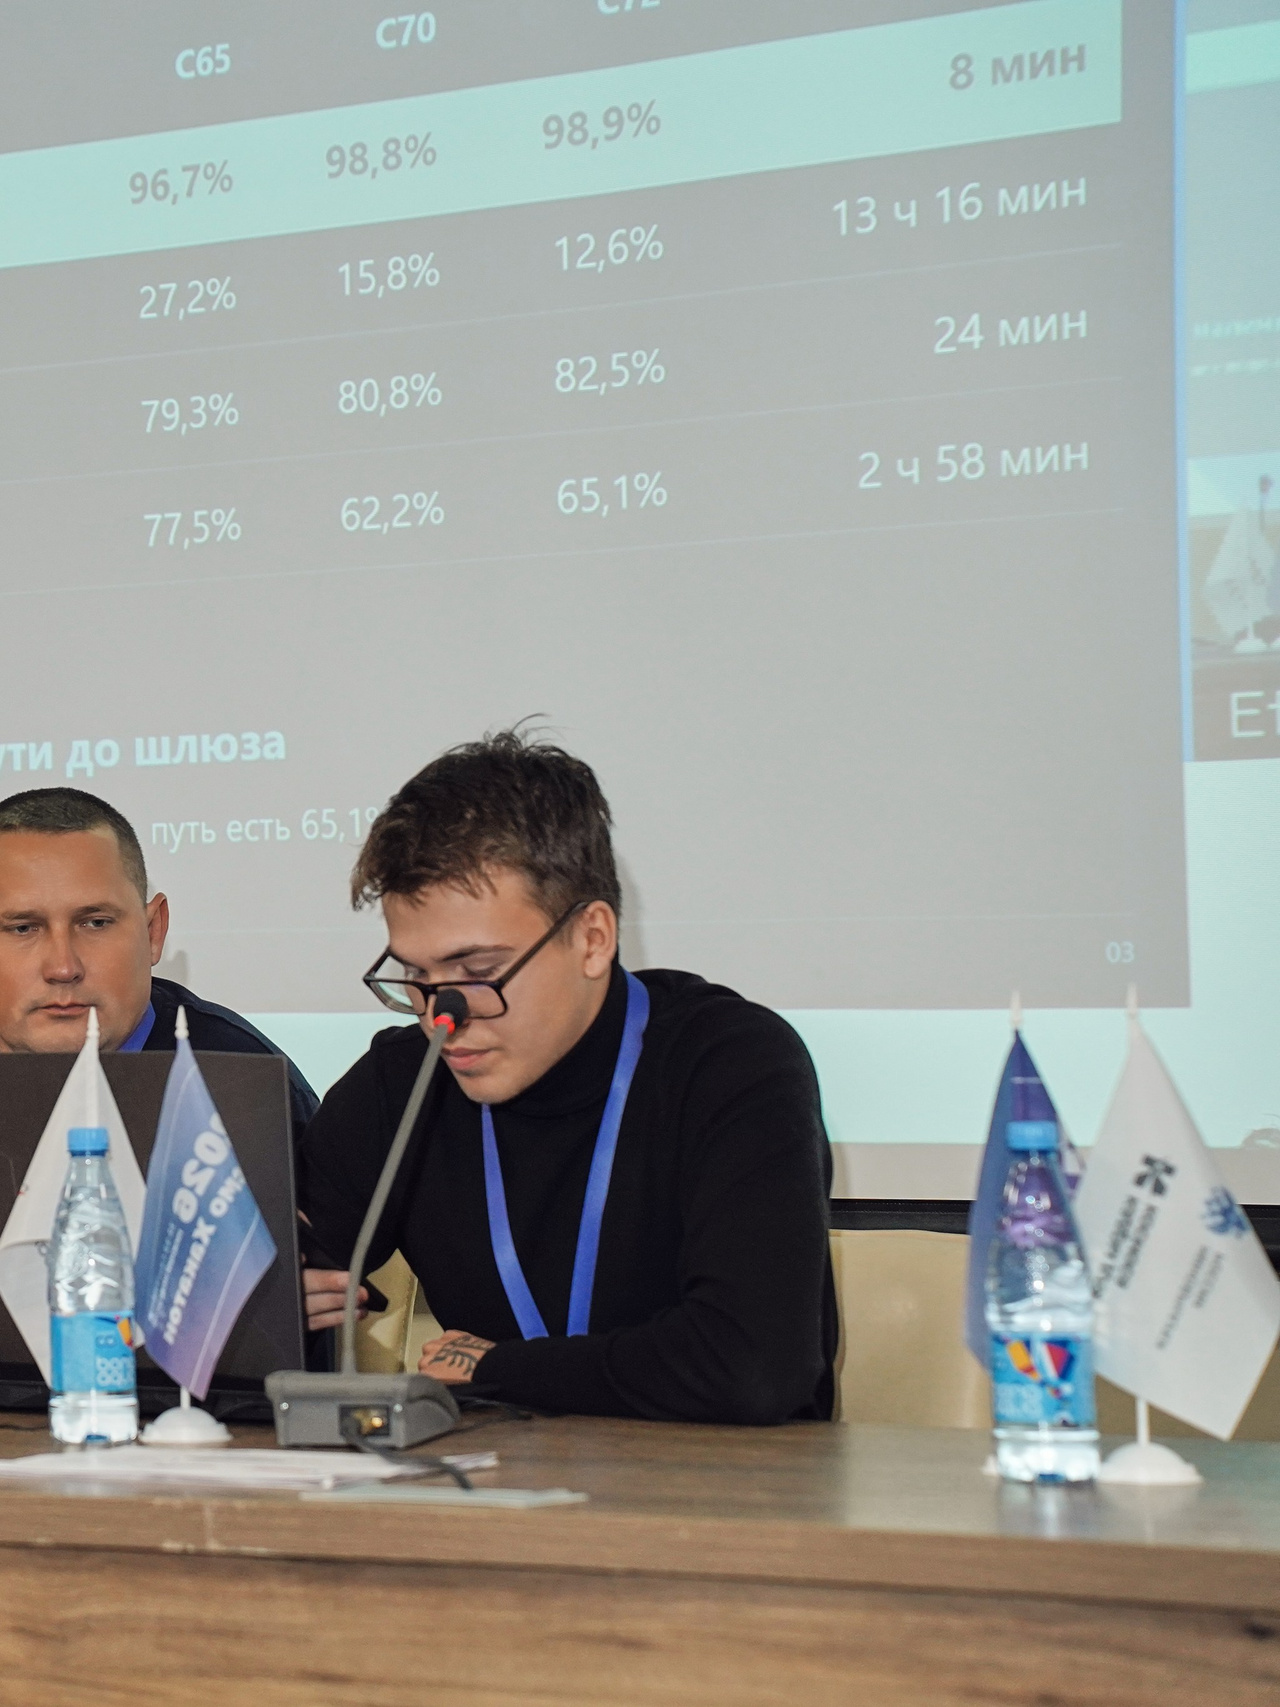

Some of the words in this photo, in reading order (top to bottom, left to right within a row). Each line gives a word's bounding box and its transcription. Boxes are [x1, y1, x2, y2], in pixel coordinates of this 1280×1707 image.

[949, 52, 975, 91] 8
[990, 43, 1087, 86] мин
[542, 99, 662, 150] 98,9%
[325, 131, 438, 180] 98,8%
[128, 159, 234, 206] 96,7%
[832, 196, 877, 236] 13
[894, 199, 918, 228] ч
[935, 181, 984, 224] 16
[996, 177, 1088, 217] мин
[554, 223, 665, 273] 12,6%
[337, 251, 441, 298] 15,8%
[138, 276, 237, 321] 27,2%
[933, 313, 985, 355] 24
[999, 310, 1088, 347] мин
[337, 371, 443, 417] 80,8%
[553, 347, 667, 396] 82,5%
[140, 392, 240, 436] 79,3%
[858, 451, 882, 490] 2
[897, 456, 920, 484] ч
[936, 442, 986, 483] 58
[1000, 442, 1090, 478] мин
[340, 490, 446, 535] 62,2%
[556, 470, 669, 518] 65,1%
[143, 507, 242, 550] 77,5%
[66, 736, 120, 777] до
[135, 731, 287, 767] шлюза
[151, 819, 217, 854] путь
[227, 815, 290, 842] есть
[1104, 941, 1135, 964] 03
